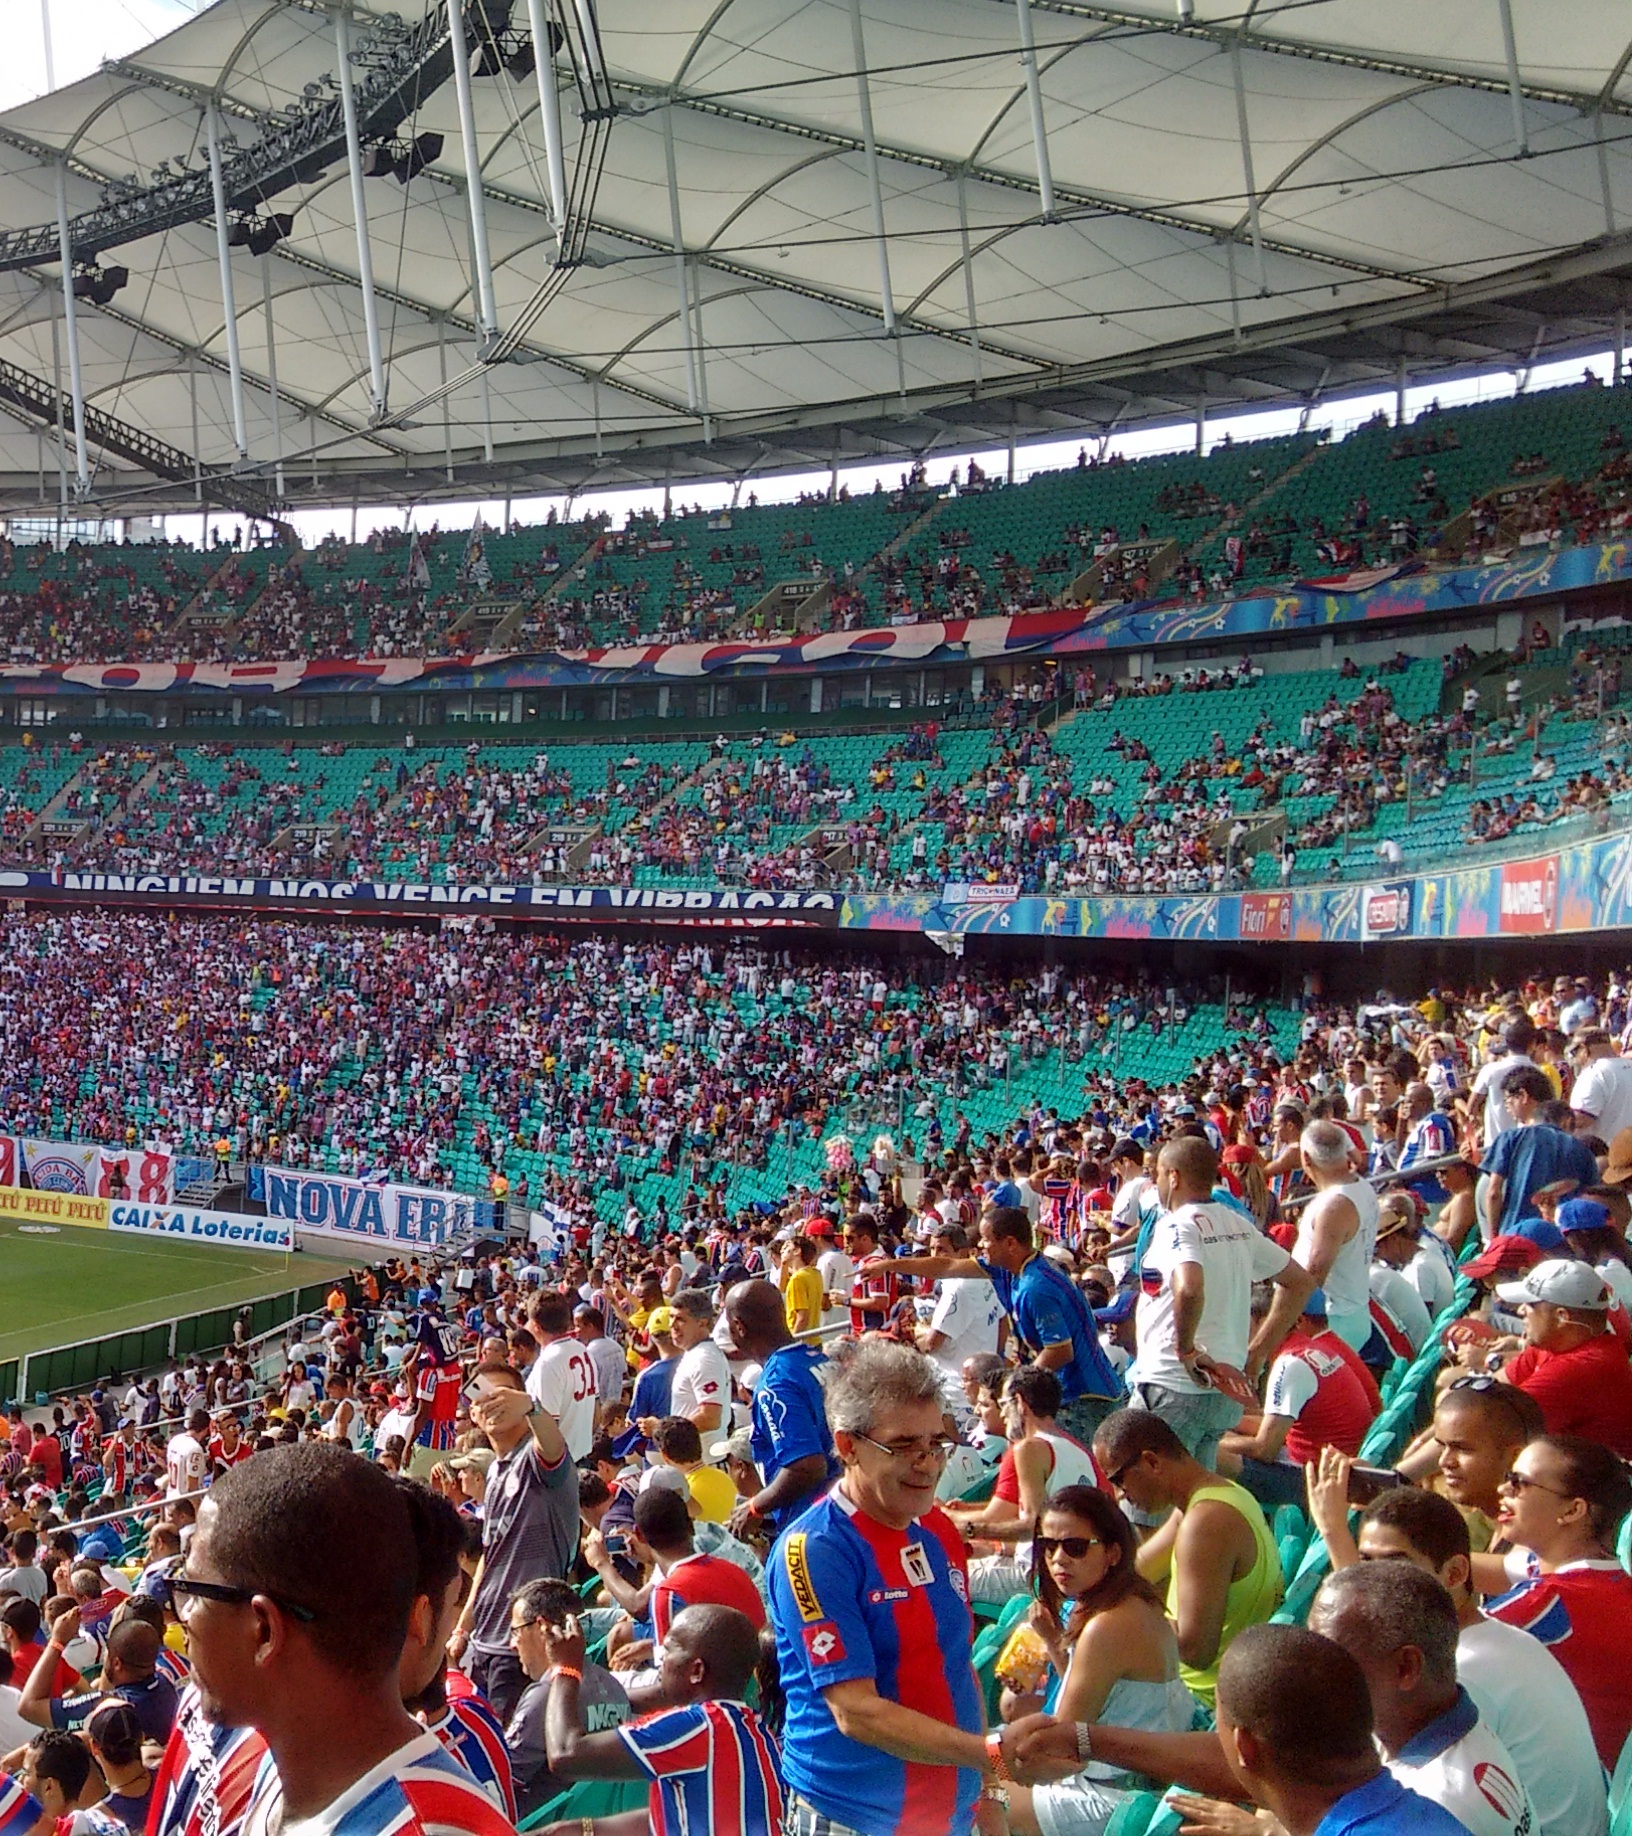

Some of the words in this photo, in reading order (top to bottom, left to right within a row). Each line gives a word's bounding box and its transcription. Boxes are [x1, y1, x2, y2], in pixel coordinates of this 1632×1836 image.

[1241, 902, 1267, 932] Fiori
[24, 1191, 62, 1215] PITÚ
[68, 1197, 107, 1222] PITÚ
[111, 1205, 185, 1233] CAIXA
[192, 1216, 290, 1246] Loterias
[267, 1172, 390, 1238] NOVA
[569, 1351, 596, 1402] 31
[787, 1541, 816, 1617] VEDACIT
[884, 1589, 909, 1600] lotto
